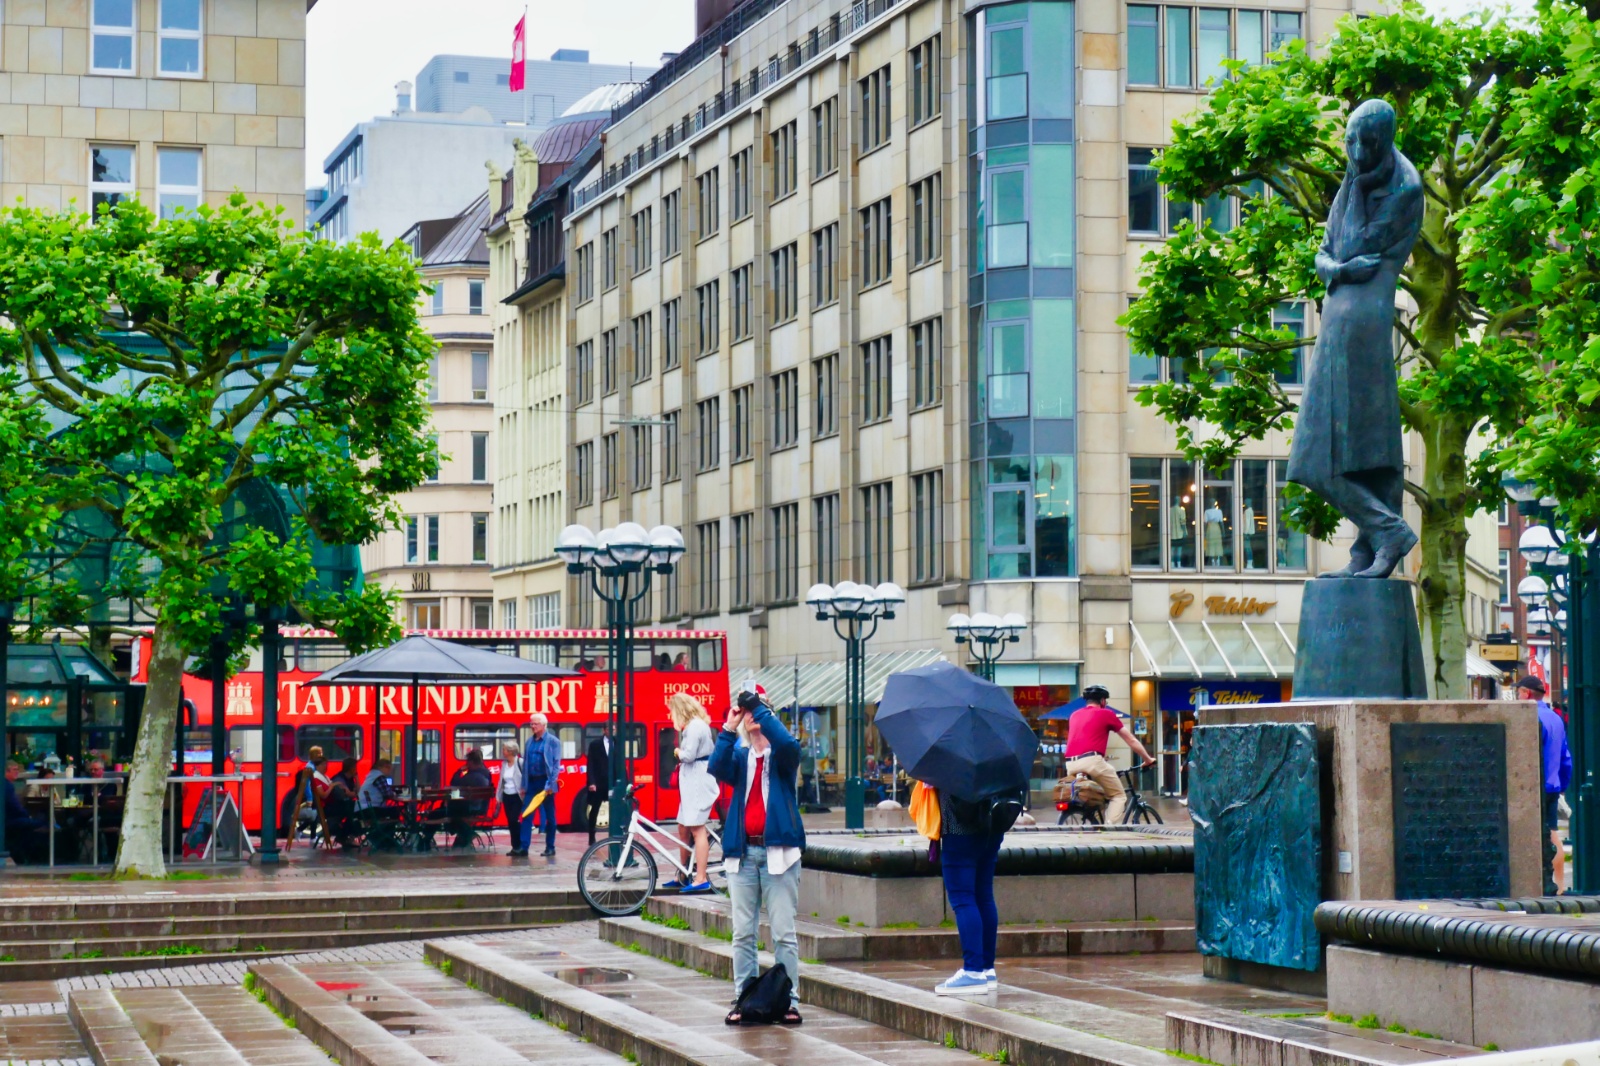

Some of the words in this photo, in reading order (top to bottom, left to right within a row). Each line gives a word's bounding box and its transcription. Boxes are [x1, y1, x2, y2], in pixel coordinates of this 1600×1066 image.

[1204, 596, 1278, 616] Tchibo
[664, 683, 689, 694] HOP
[691, 683, 710, 694] ON
[1212, 690, 1264, 704] Tchibo
[276, 680, 582, 715] TADTRUNDFAHRT
